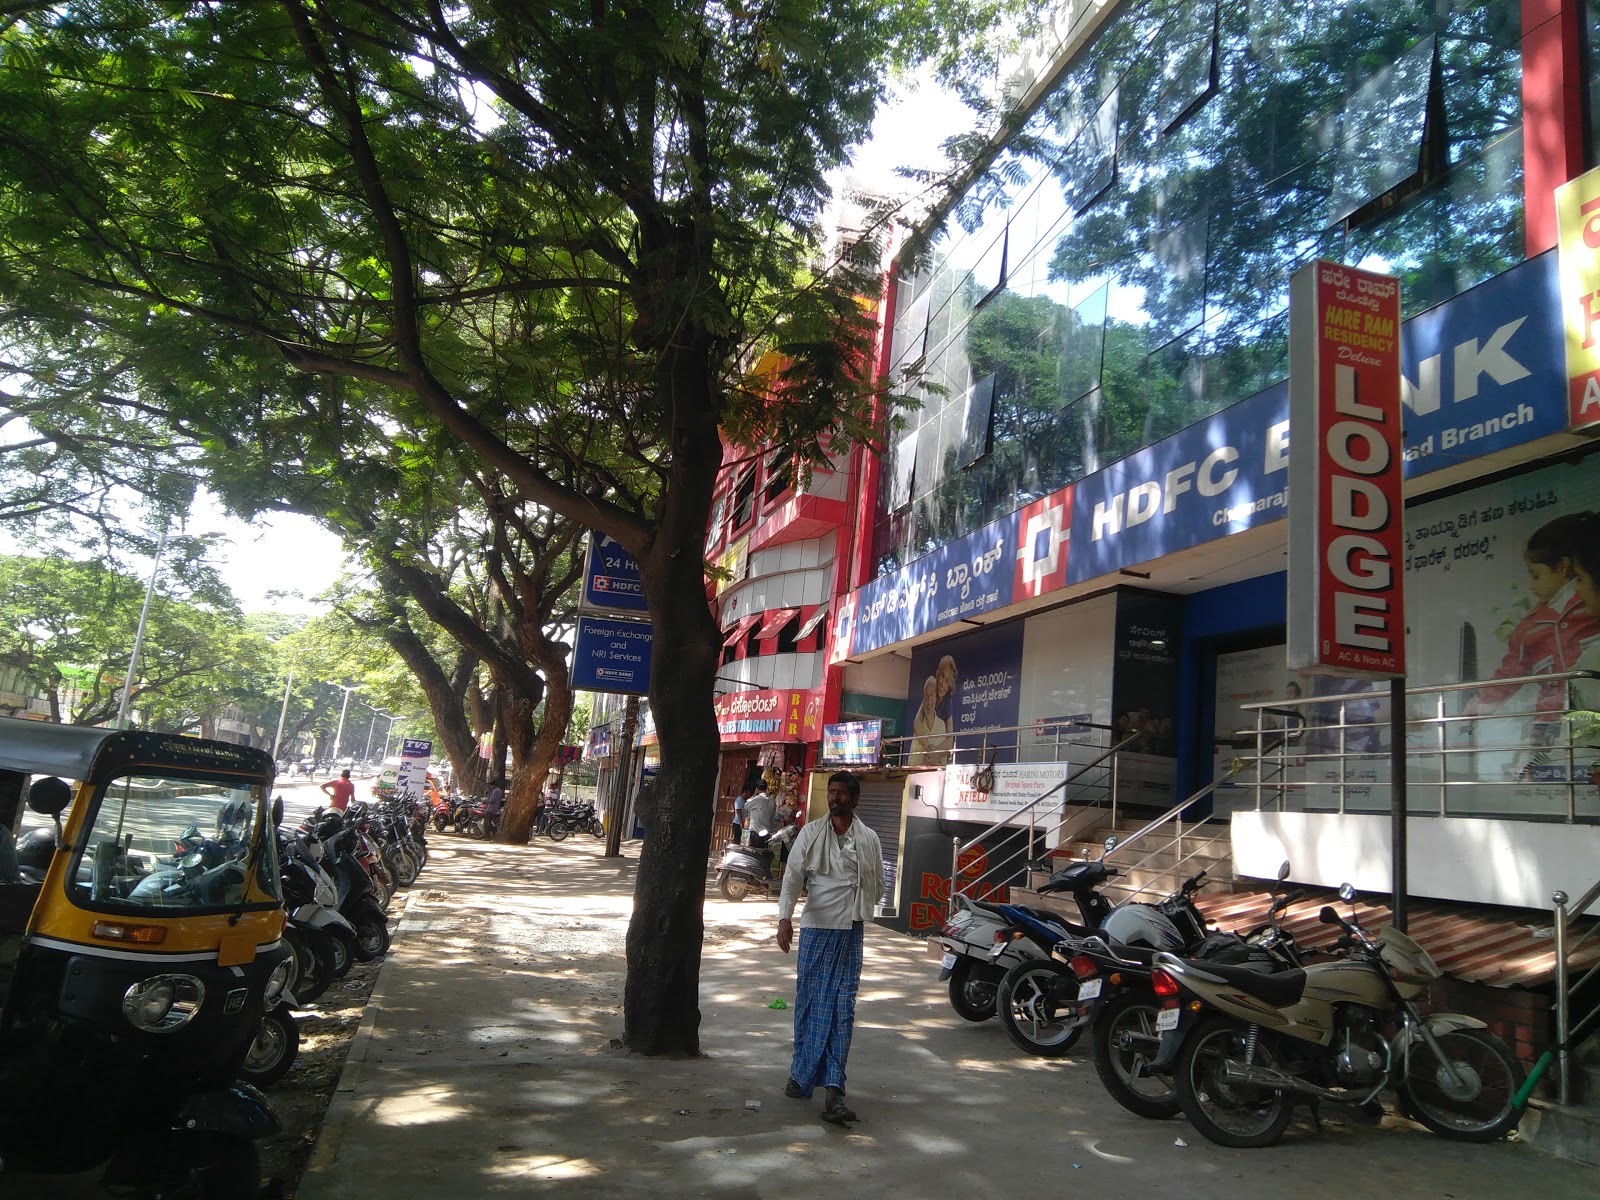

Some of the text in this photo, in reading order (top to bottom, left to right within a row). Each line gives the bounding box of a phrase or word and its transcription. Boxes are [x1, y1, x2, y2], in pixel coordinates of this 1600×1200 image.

[1325, 304, 1394, 338] HARE RAM
[1325, 326, 1394, 352] RESIDENCY
[1338, 346, 1382, 366] Deluxe
[1441, 403, 1534, 450] Branch
[1091, 446, 1240, 541] HDFC
[1326, 363, 1391, 653] LODGE
[606, 557, 621, 568] 24
[946, 538, 1004, 600] ಬ್ಯಾಂಕ್
[612, 581, 641, 592] HDFC
[584, 625, 615, 639] Foreign
[610, 640, 627, 649] and
[592, 649, 607, 659] NRI
[1338, 651, 1395, 668] AC & Non AC
[787, 693, 801, 735] BAR
[725, 719, 782, 734] RESTAURANT
[405, 740, 430, 750] TVS
[1019, 770, 1064, 778] HARINI MOTORS
[1021, 781, 1033, 789] Spare
[956, 790, 988, 803] NFIELD
[921, 872, 1011, 904] ROYAL
